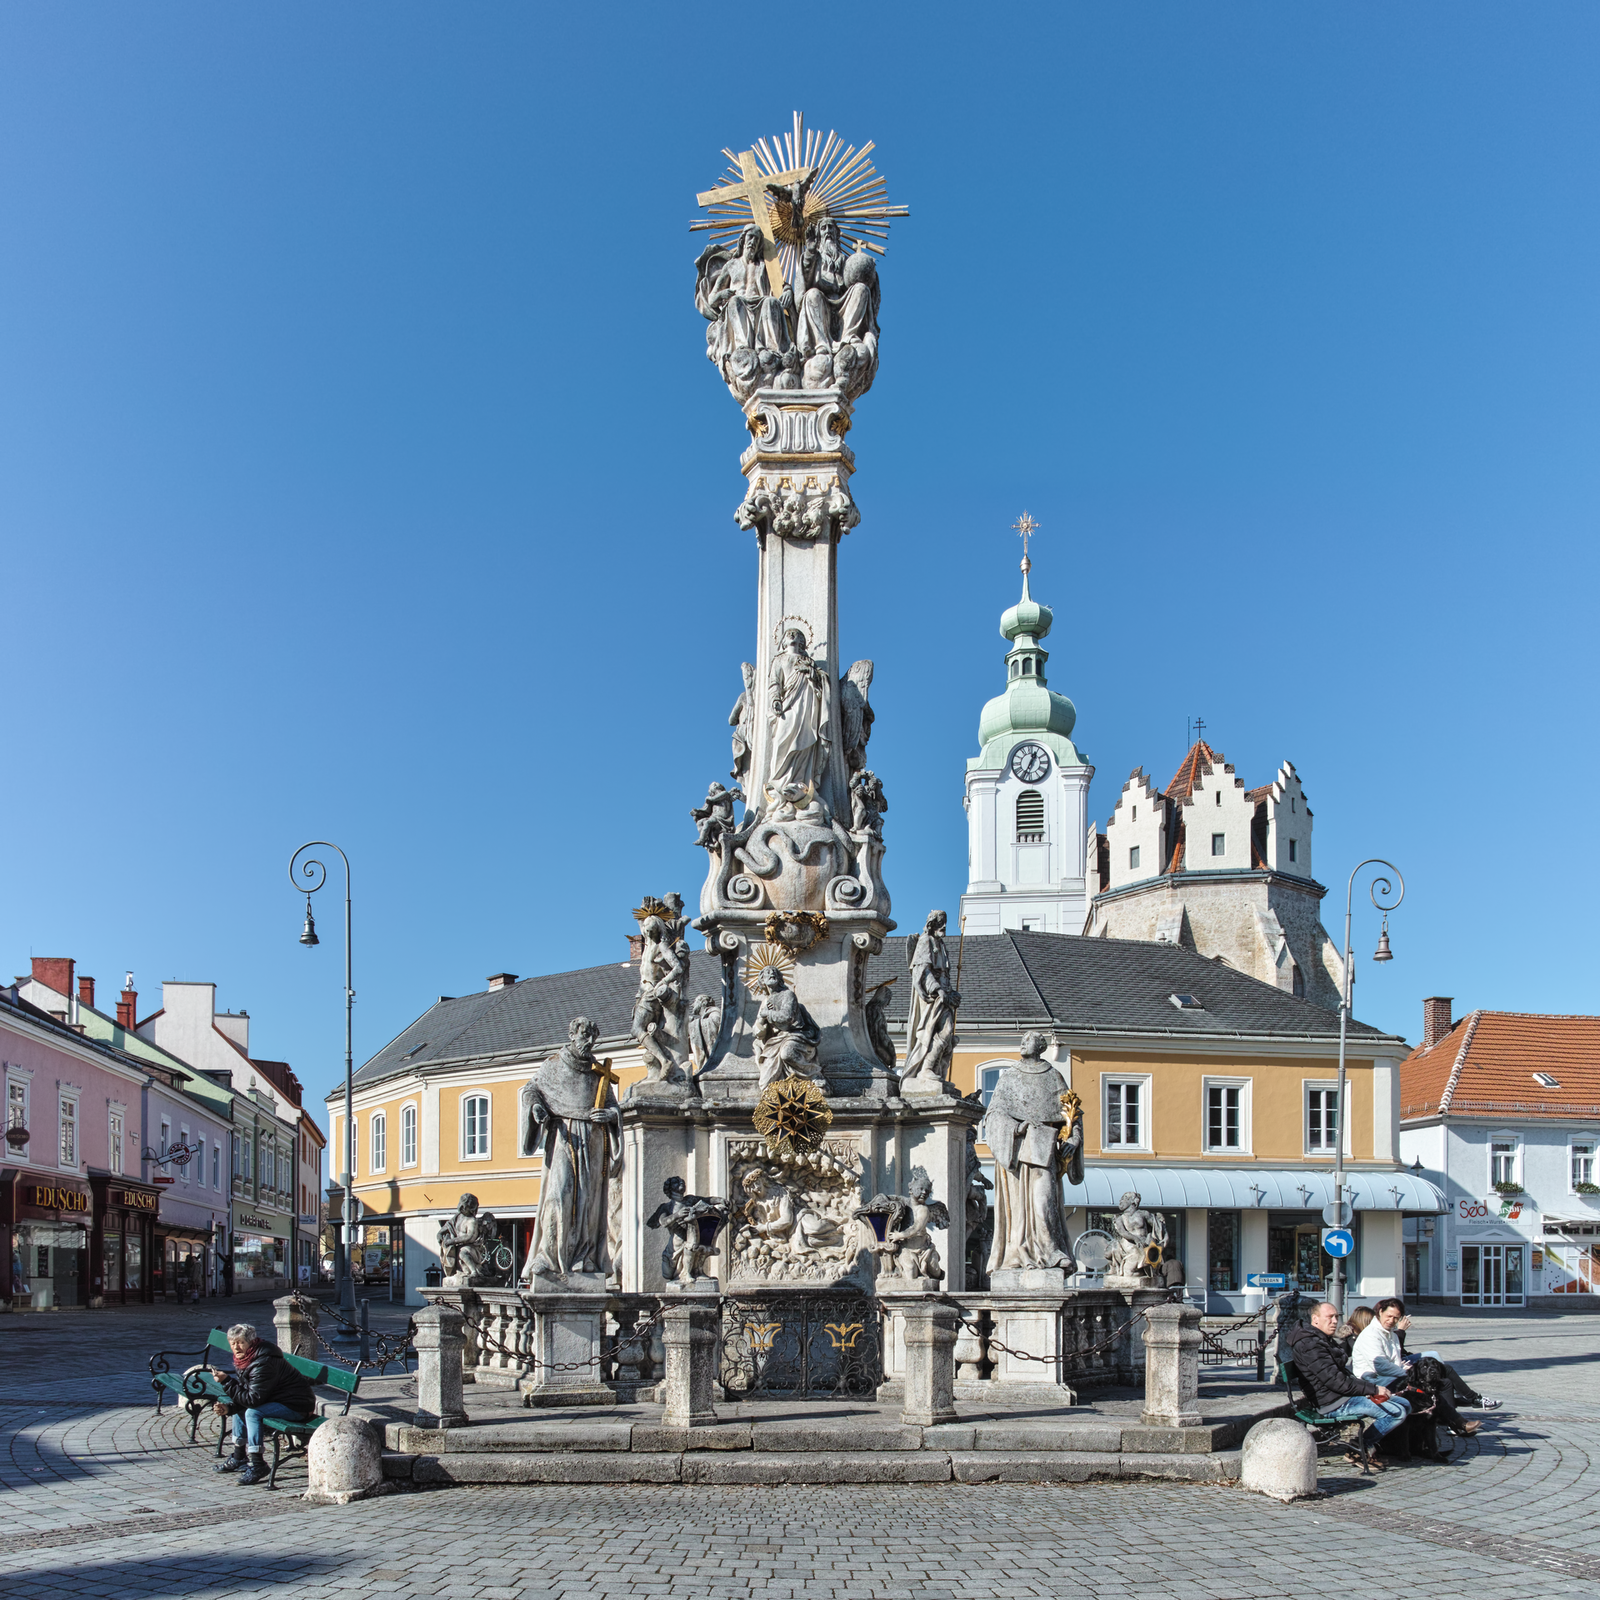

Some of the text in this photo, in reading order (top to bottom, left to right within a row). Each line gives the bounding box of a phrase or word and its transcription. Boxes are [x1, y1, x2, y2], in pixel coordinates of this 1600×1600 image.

[36, 1186, 88, 1212] EDUSCHO
[124, 1191, 156, 1209] EDUSCHO
[1459, 1199, 1489, 1219] Seidl
